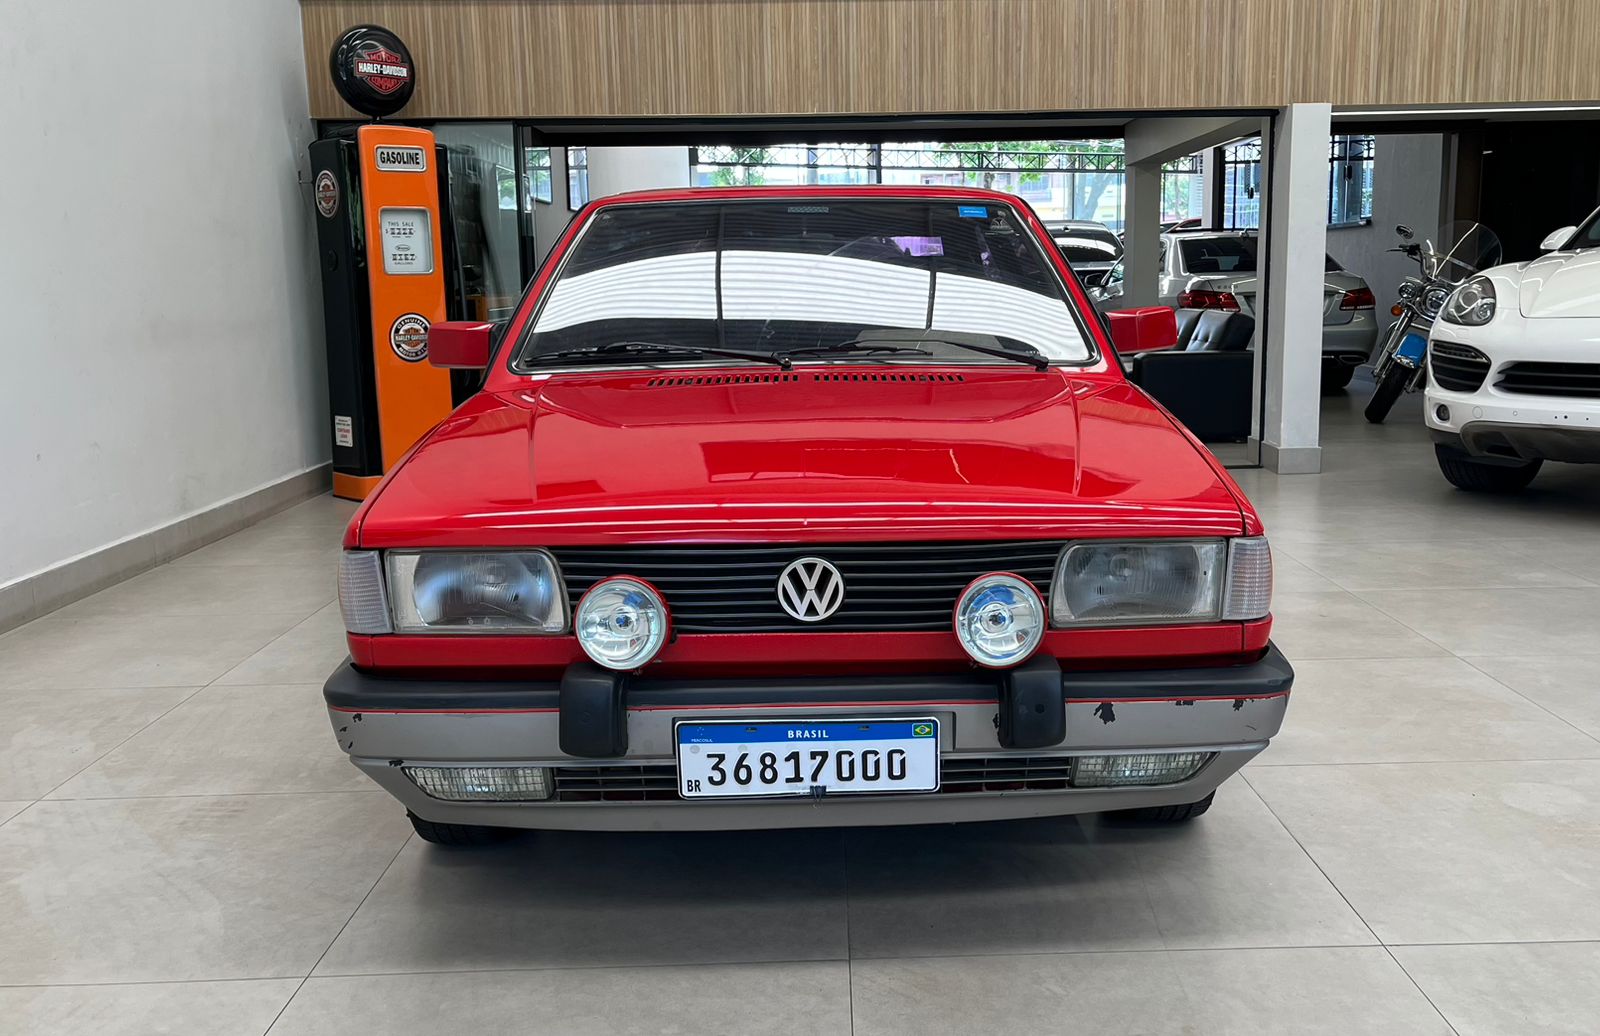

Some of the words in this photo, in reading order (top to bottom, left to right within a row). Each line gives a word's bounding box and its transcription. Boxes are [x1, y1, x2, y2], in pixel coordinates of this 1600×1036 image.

[370, 52, 397, 63] MOTOR
[358, 62, 407, 77] HARLEY-DAVIDSON
[379, 151, 420, 165] GASOLINE
[397, 318, 426, 329] GENUINE
[398, 347, 416, 357] MOTOR
[787, 729, 829, 739] BRASIL
[706, 748, 906, 786] 36817000
[686, 779, 702, 793] BR
